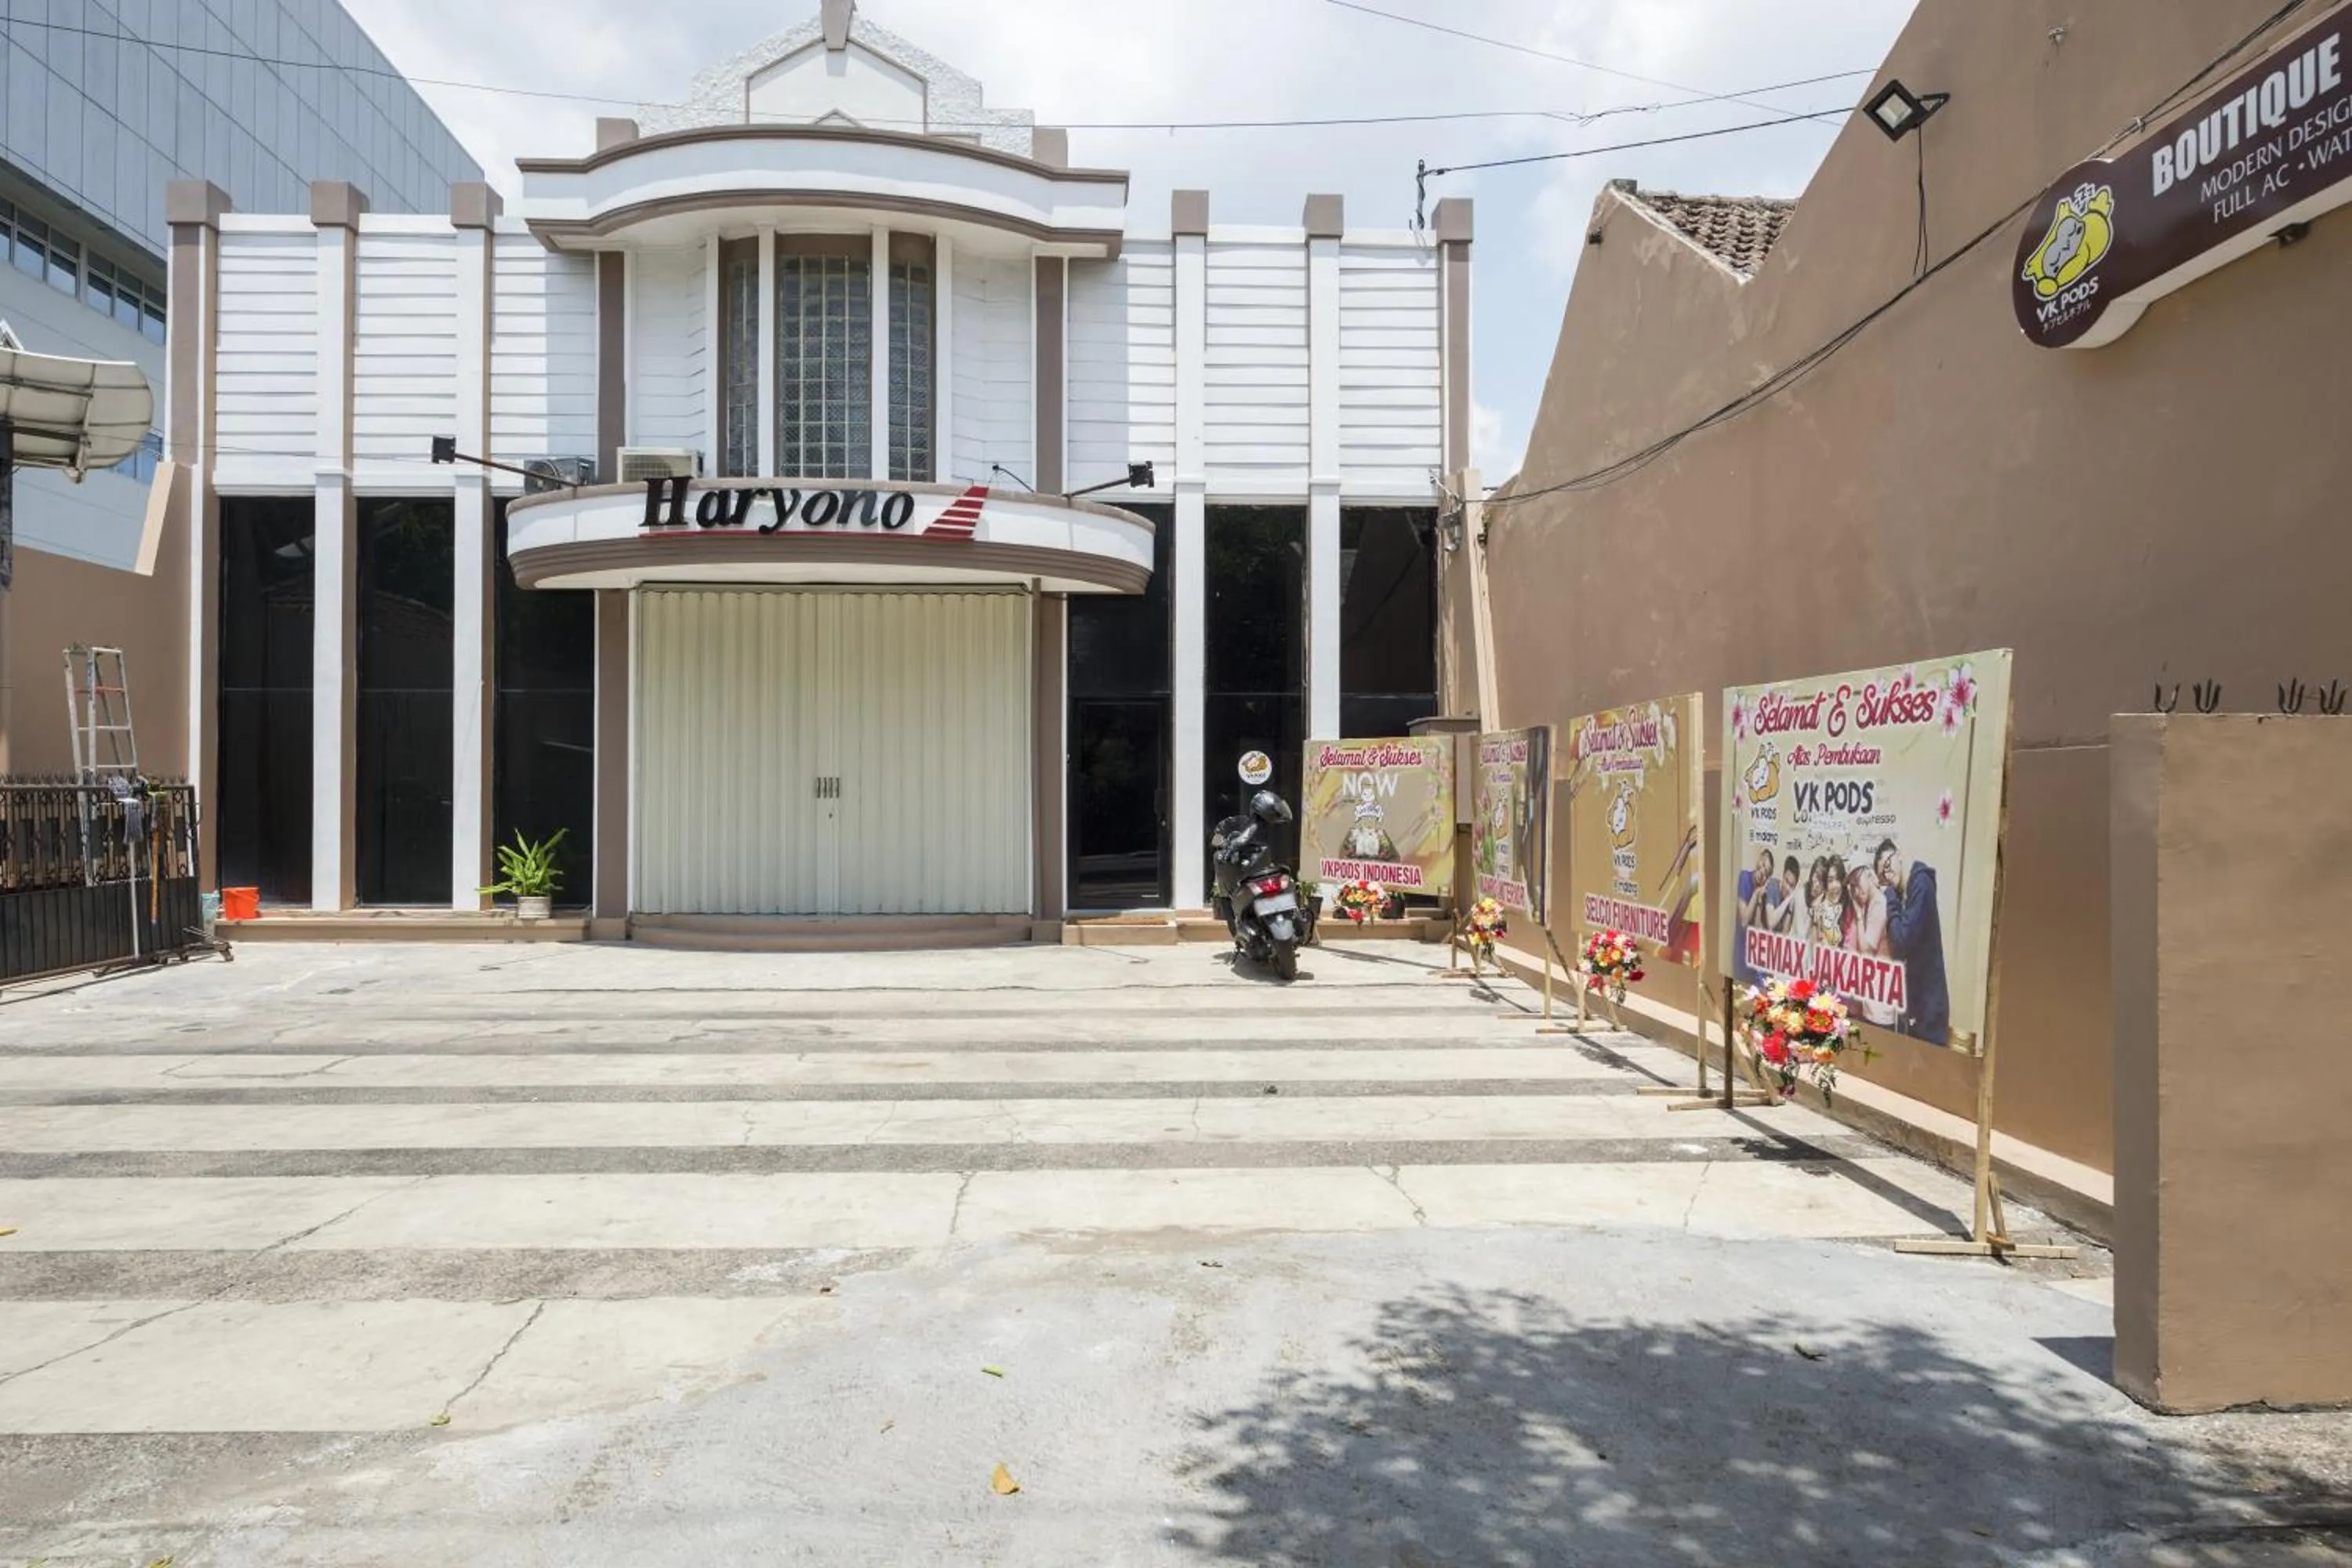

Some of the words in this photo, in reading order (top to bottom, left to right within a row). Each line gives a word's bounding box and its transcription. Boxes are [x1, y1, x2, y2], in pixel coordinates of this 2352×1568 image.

[2151, 32, 2341, 198] BOUTIQUE
[2201, 136, 2282, 203] MODERN
[2214, 185, 2256, 224] FULL
[2262, 163, 2290, 198] AC
[2036, 300, 2059, 322] VK
[2061, 275, 2099, 310] PODS
[638, 476, 916, 535] Haryono
[1754, 691, 1826, 735] Selamat
[1856, 681, 1937, 729] Sukses
[1320, 746, 1367, 768] Selamat
[1379, 745, 1422, 768] Sukses
[1342, 771, 1399, 797] NOW
[1794, 780, 1820, 813] VK
[1824, 780, 1875, 814] PODS
[1321, 860, 1360, 880] VKPODS
[1363, 863, 1421, 885] INDONESIA
[1586, 895, 1611, 926] SELCO
[1613, 900, 1668, 942] FURNITURE
[1748, 929, 1806, 978] REMAX
[1809, 946, 1904, 1008] JAKARTA
